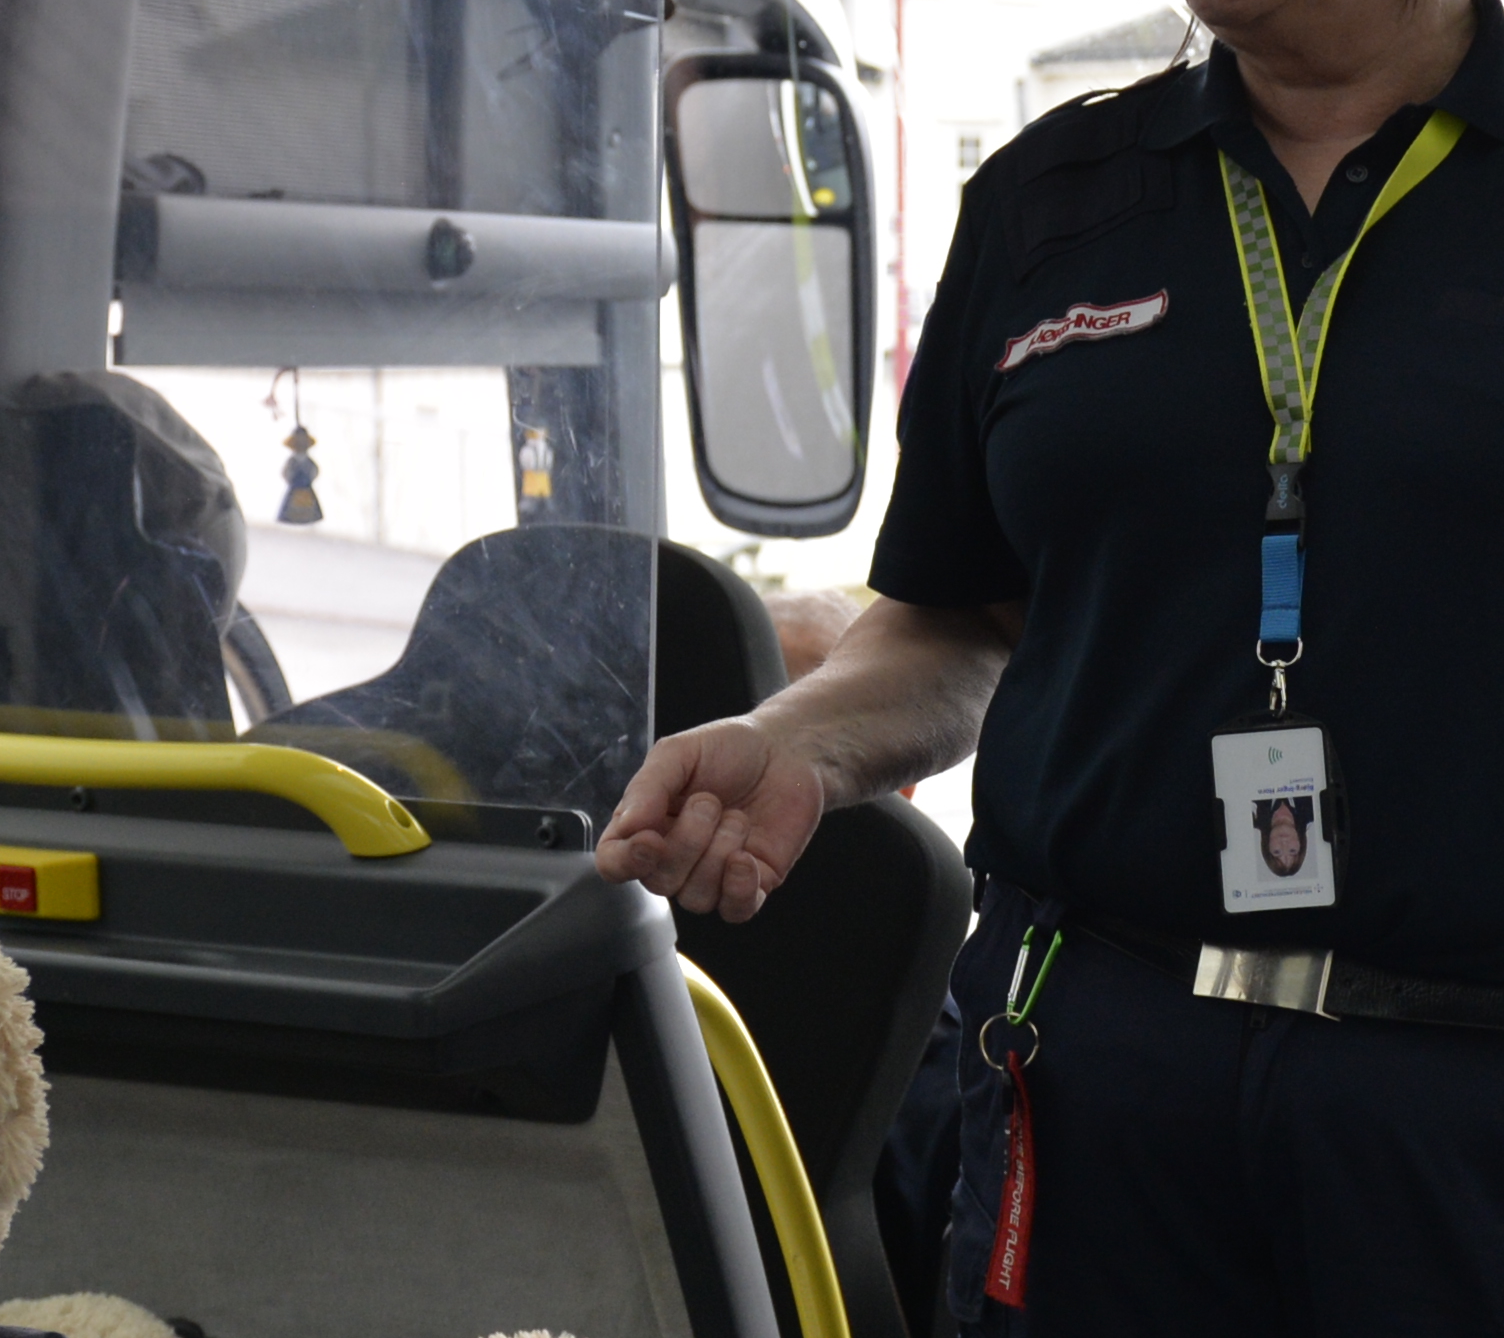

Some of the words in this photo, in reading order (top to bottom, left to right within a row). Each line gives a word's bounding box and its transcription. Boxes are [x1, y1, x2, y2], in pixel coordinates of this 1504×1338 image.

[1, 886, 30, 903] STOP
[1009, 1158, 1026, 1228] BEFORE
[998, 1228, 1019, 1291] FLIGHT
